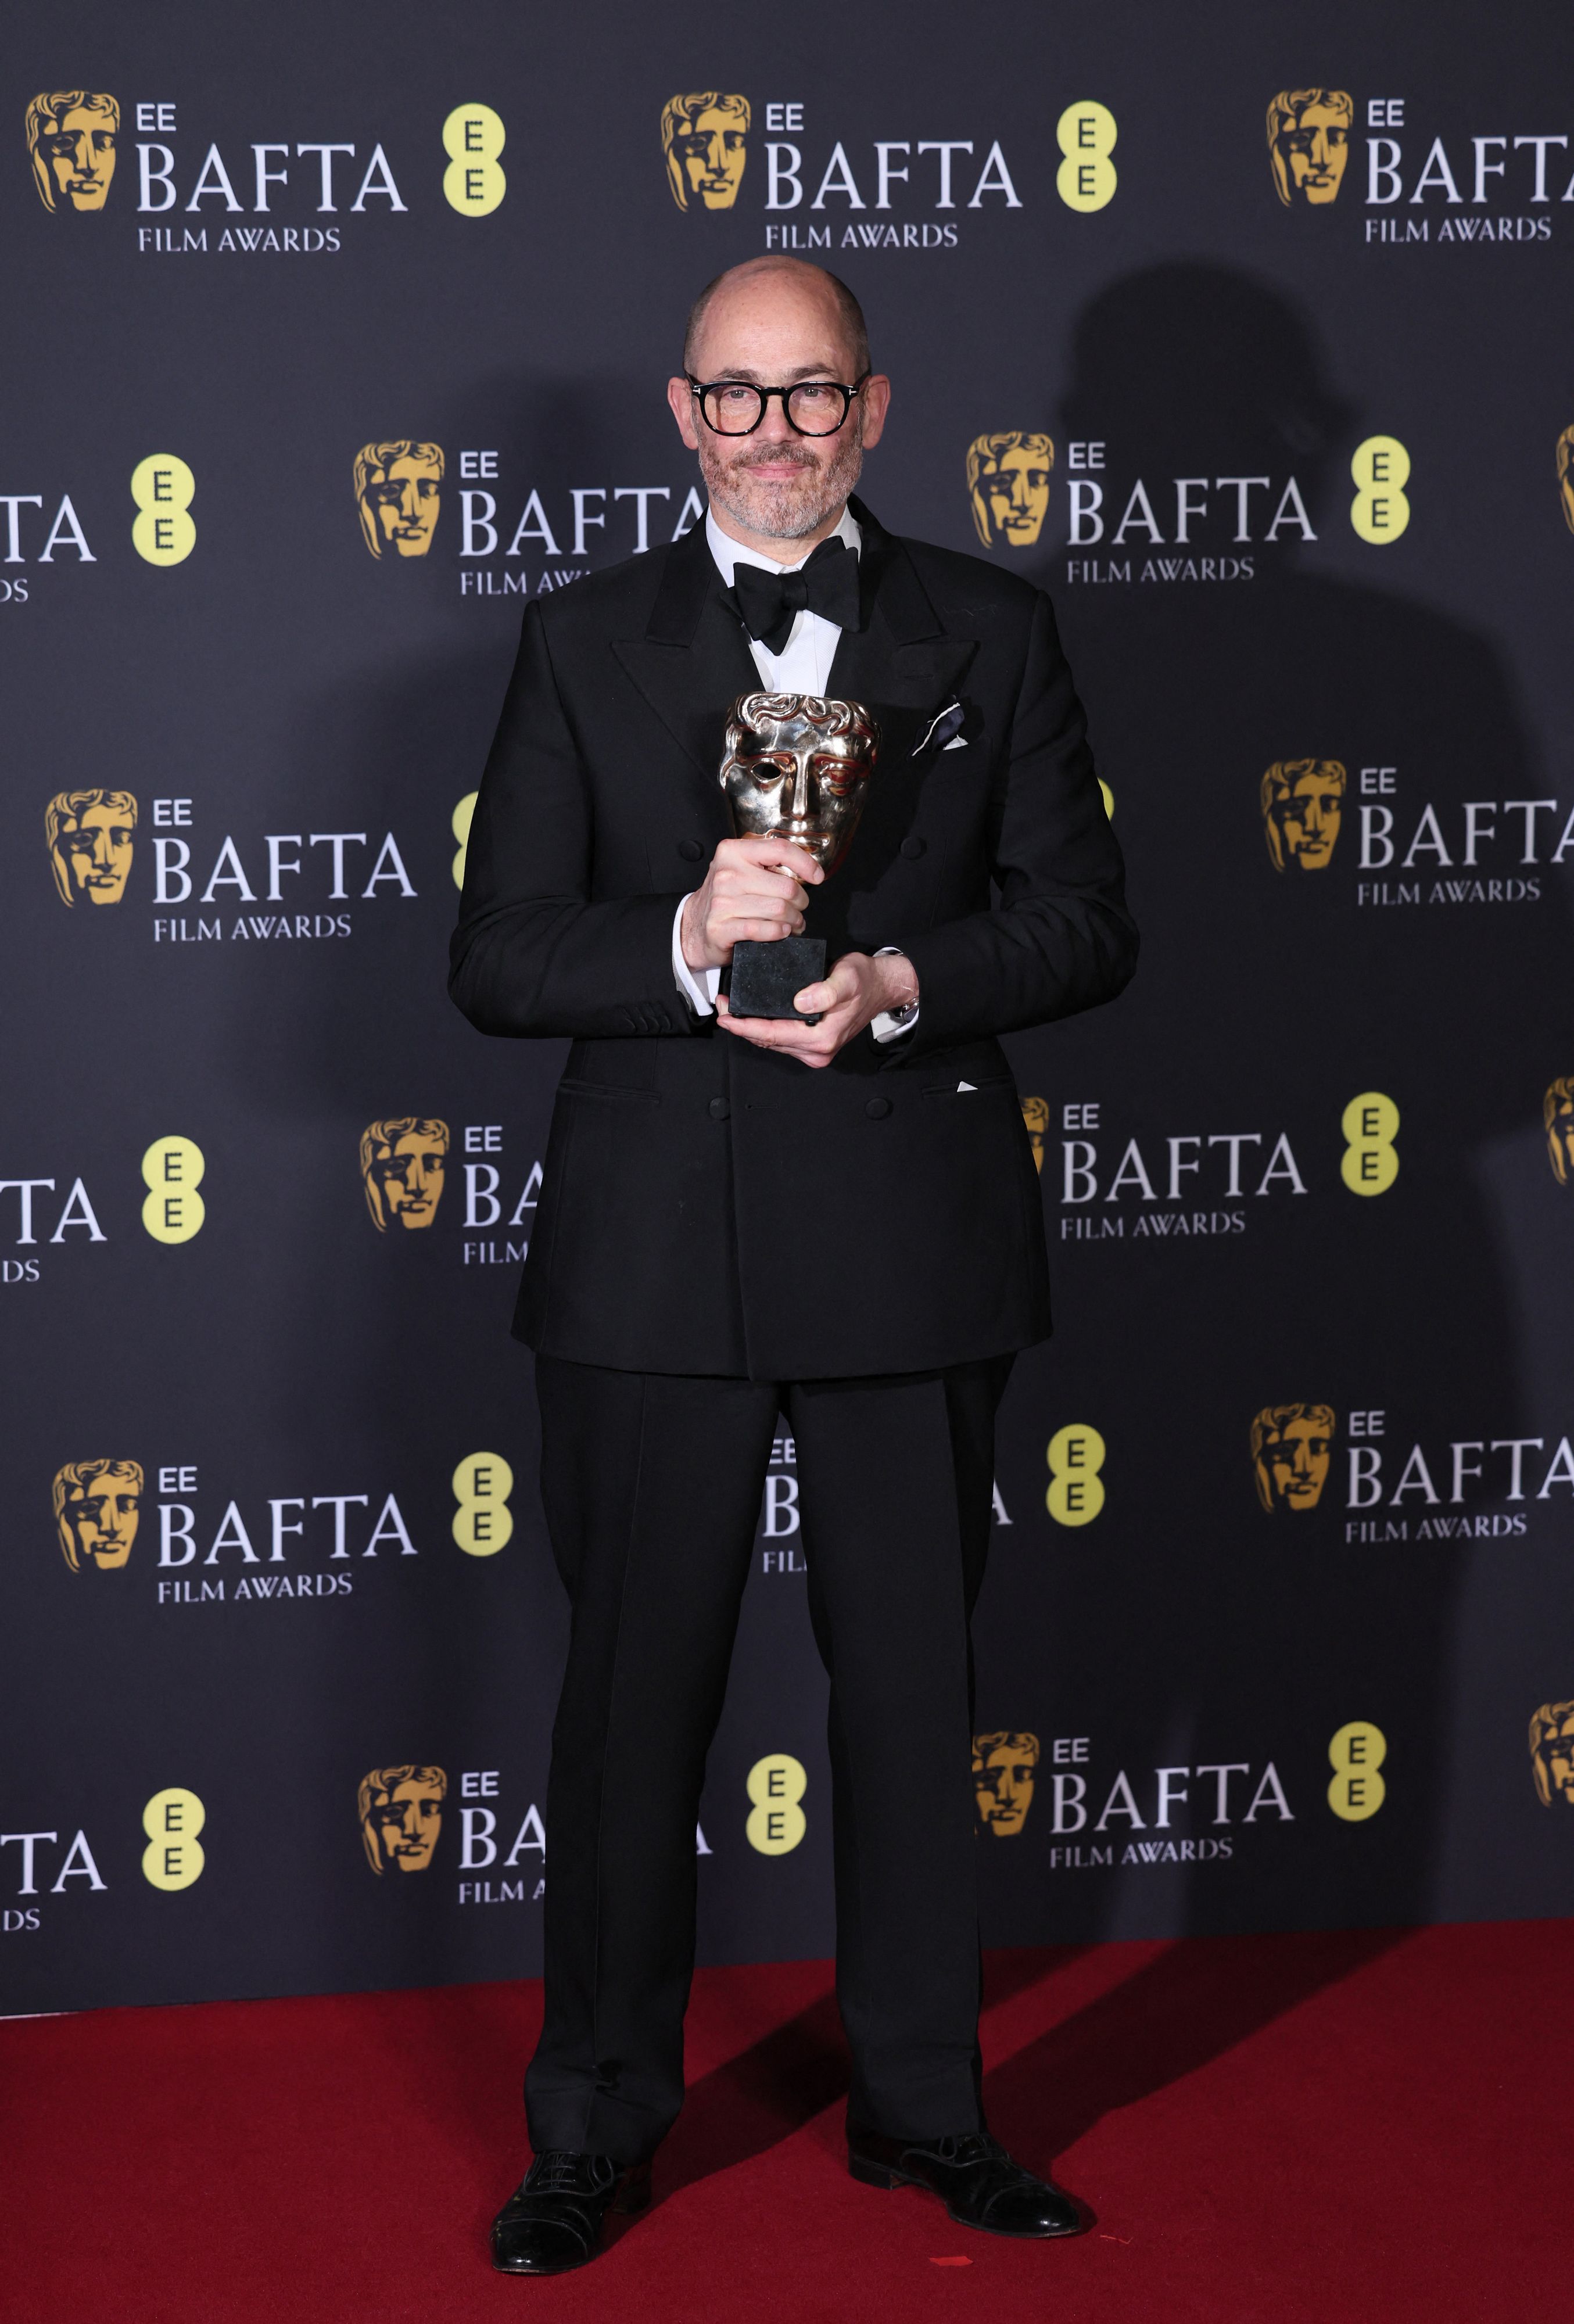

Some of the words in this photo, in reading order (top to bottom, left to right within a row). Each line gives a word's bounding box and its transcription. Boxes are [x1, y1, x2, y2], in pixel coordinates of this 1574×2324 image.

[137, 103, 177, 131] EE
[766, 103, 804, 131] EE
[1368, 99, 1404, 127] EE
[135, 143, 408, 212] BAFTA
[765, 141, 1023, 210] BAFTA
[138, 228, 207, 252] FILM
[218, 228, 340, 252] AWARDS
[766, 225, 831, 249] FILM
[841, 224, 958, 248] AWARDS
[1365, 219, 1429, 242] FILM
[1438, 217, 1551, 242] AWARDS
[460, 451, 499, 479] EE
[1069, 442, 1105, 469] EE
[1067, 477, 1318, 545] BAFTA
[461, 571, 527, 596] FILM
[1067, 560, 1131, 583] FILM
[1141, 557, 1254, 582] AWARDS
[1361, 768, 1396, 794] EE
[153, 799, 193, 826] EE
[152, 833, 417, 903] BAFTA
[1358, 883, 1420, 906] FILM
[1429, 879, 1540, 903] AWARDS
[154, 918, 221, 942] FILM
[231, 914, 351, 940] AWARDS
[1064, 1104, 1099, 1130] EE
[465, 1125, 503, 1152] EE
[1062, 1133, 1307, 1203] BAFTA
[1061, 1217, 1124, 1240] FILM
[1133, 1212, 1245, 1236] AWARDS
[464, 1242, 528, 1265] FILM
[1349, 1411, 1385, 1436] EE
[159, 1466, 198, 1493] EE
[1348, 1436, 1574, 1507] BAFTA
[157, 1493, 417, 1567] BAFTA
[1346, 1521, 1407, 1543] FILM
[1416, 1514, 1527, 1540] AWARDS
[763, 1550, 807, 1573] FIL
[158, 1580, 225, 1604] FILM
[234, 1573, 352, 1600] AWARDS
[1053, 1738, 1089, 1763] EE
[462, 1771, 499, 1797] EE
[1052, 1762, 1294, 1833] BAFTA
[1050, 1846, 1113, 1868] FILM
[1122, 1839, 1232, 1864] AWARDS
[459, 1880, 524, 1904] FILM
